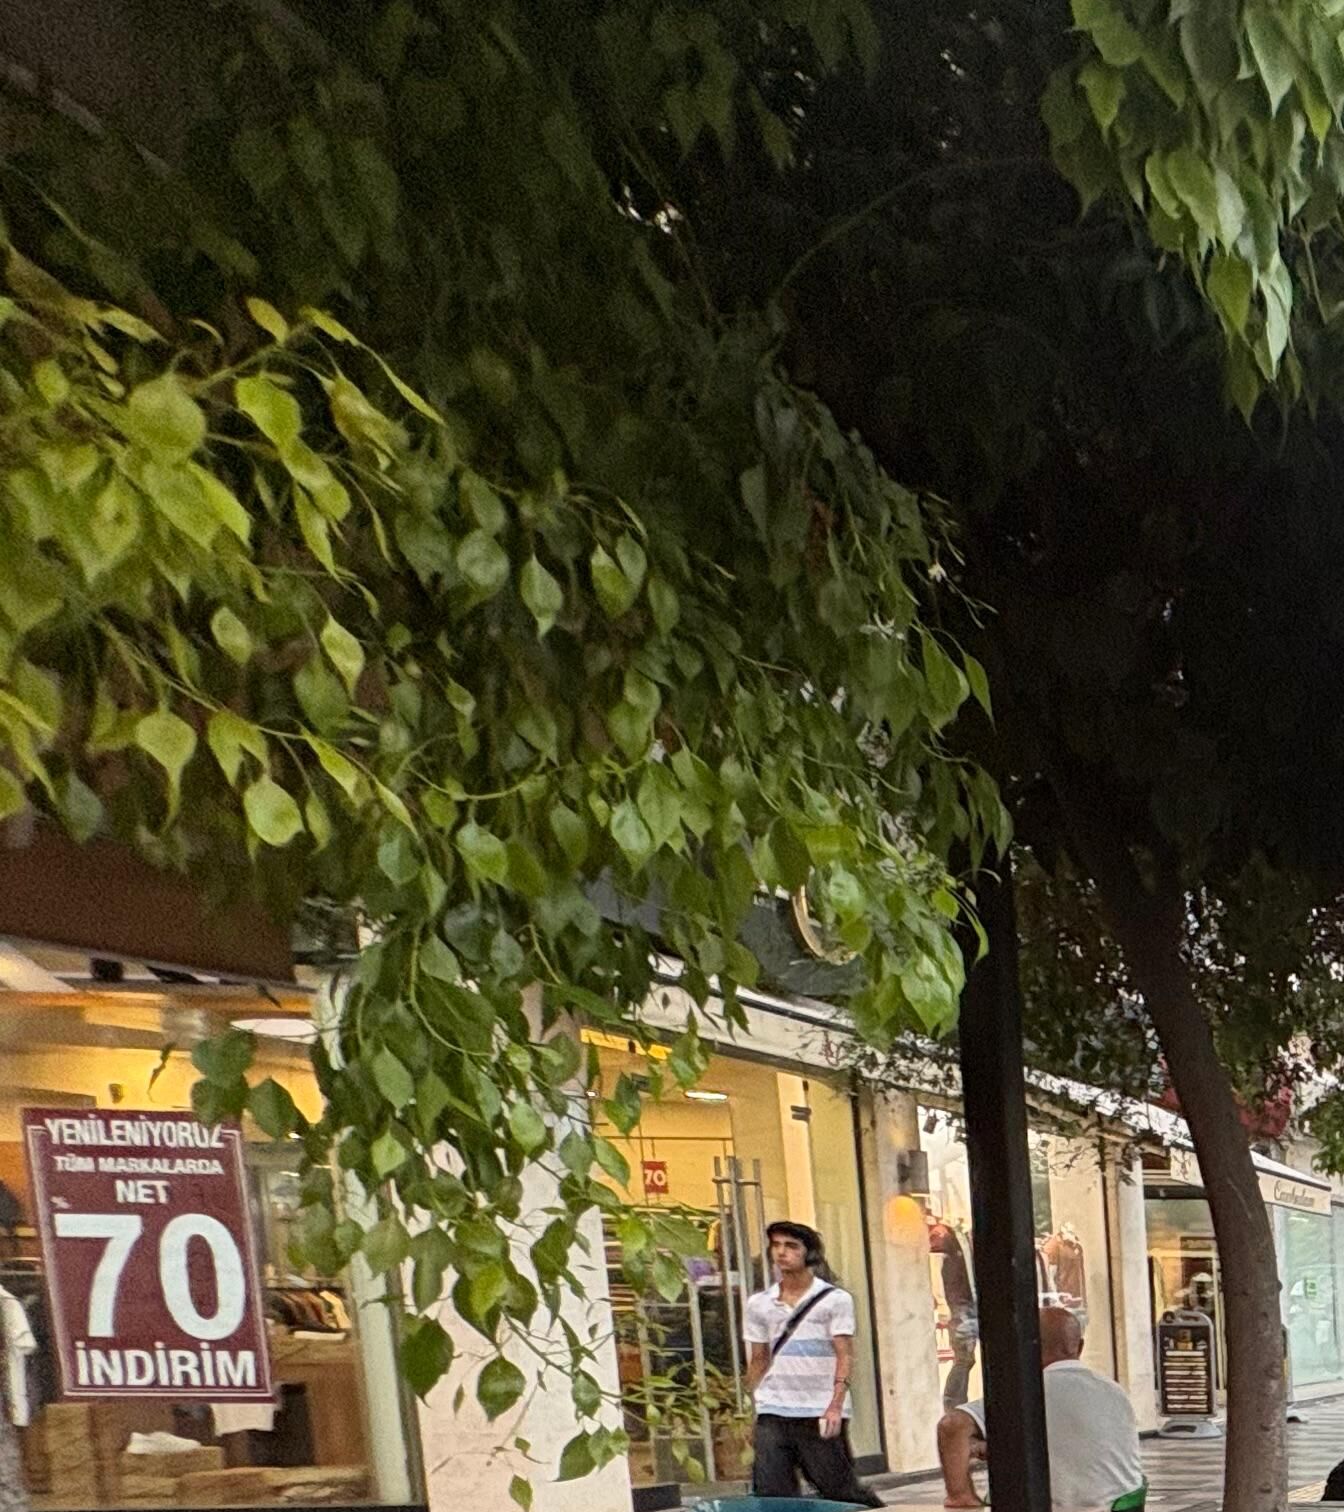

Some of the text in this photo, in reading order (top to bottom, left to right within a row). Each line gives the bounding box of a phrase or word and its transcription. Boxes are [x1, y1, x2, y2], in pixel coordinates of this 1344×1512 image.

[54, 1153, 224, 1175] TÜM MARKALARDA
[643, 1169, 667, 1186] 70
[115, 1179, 170, 1204] NET
[54, 1212, 246, 1341] 70
[75, 1341, 257, 1387] İNDİRİM
